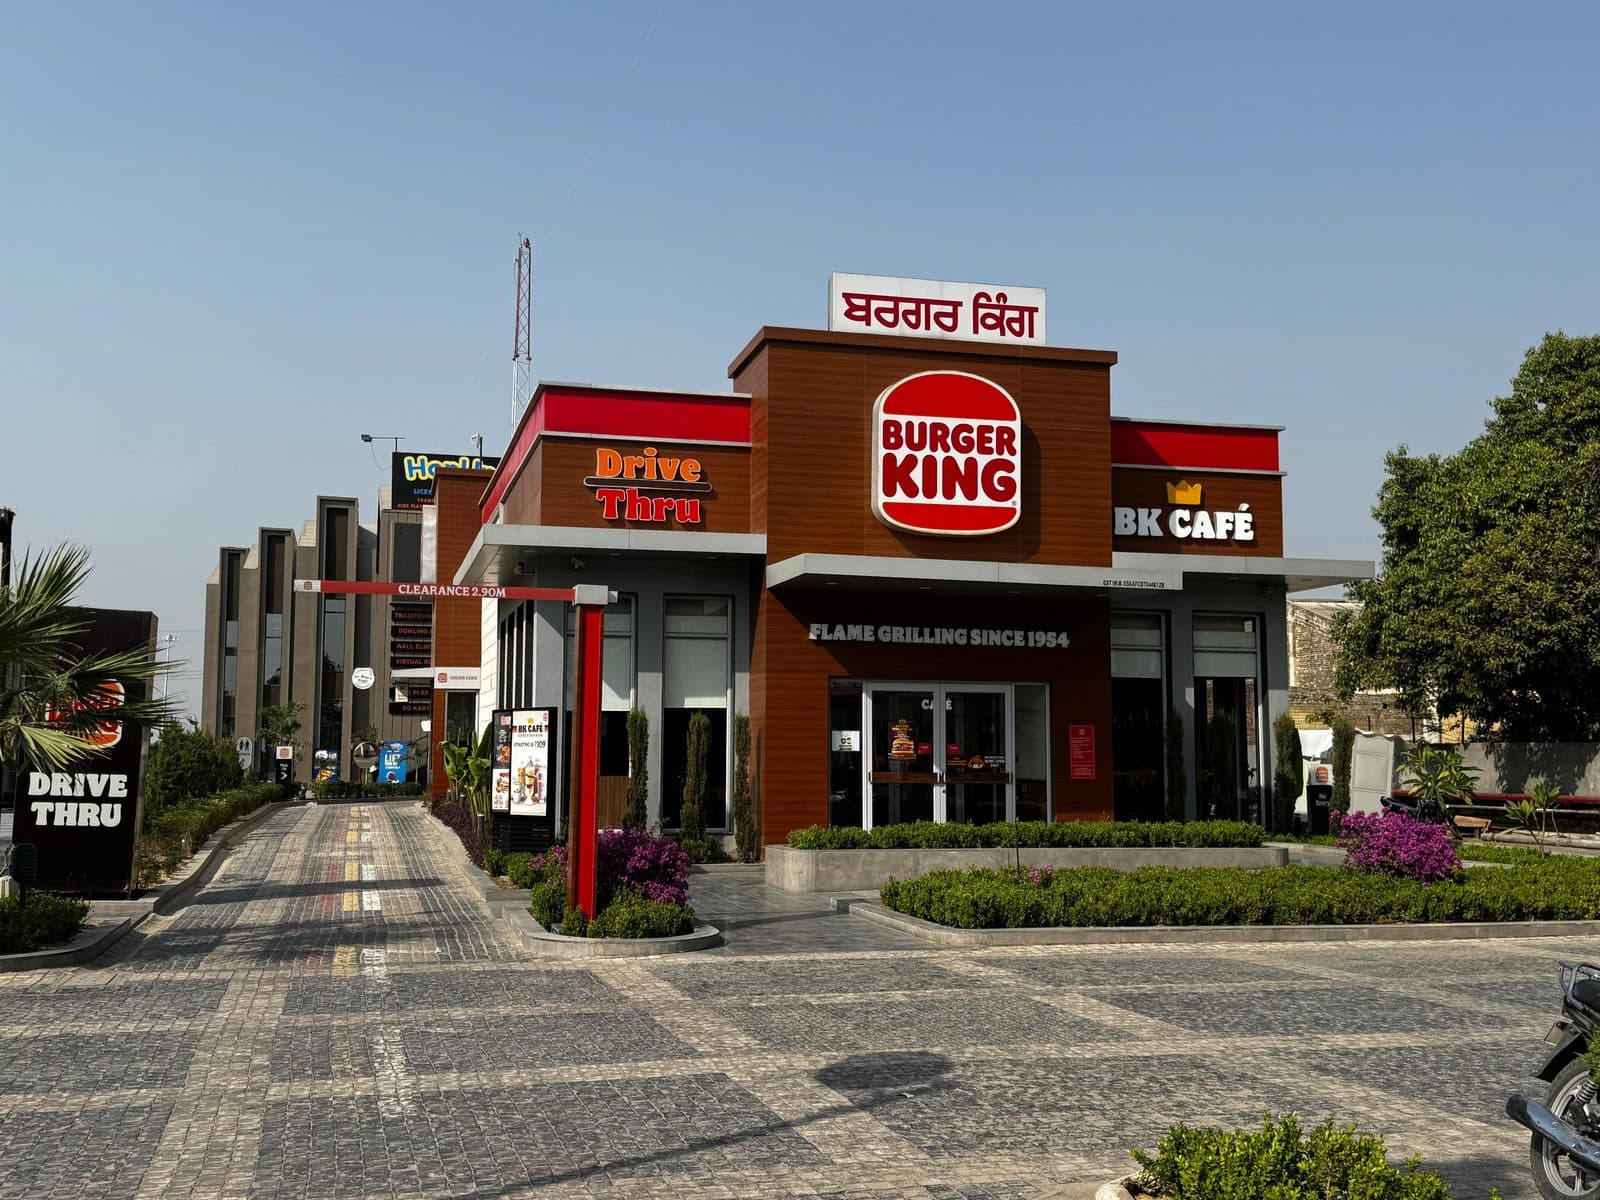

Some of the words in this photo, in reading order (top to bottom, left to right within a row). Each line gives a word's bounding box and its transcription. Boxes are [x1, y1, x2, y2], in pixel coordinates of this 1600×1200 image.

[842, 292, 963, 332] ਬਰਗਰ
[973, 291, 1039, 338] ਕਿੰਗ
[882, 419, 1016, 456] BURGER
[596, 447, 701, 482] Drive
[882, 453, 1017, 502] KING
[596, 488, 701, 523] Thru
[1114, 507, 1163, 536] BK
[1168, 503, 1254, 540] CAFÉ
[398, 584, 470, 597] CLEARANCE
[472, 587, 507, 598] 2.90M
[809, 624, 875, 642] FLAME
[878, 626, 967, 645] GRILLING
[970, 629, 1025, 646] SINCE
[1028, 631, 1070, 648] 1954
[518, 725, 527, 733] BK
[28, 772, 128, 798] DRIVE
[31, 802, 122, 828] THRU
